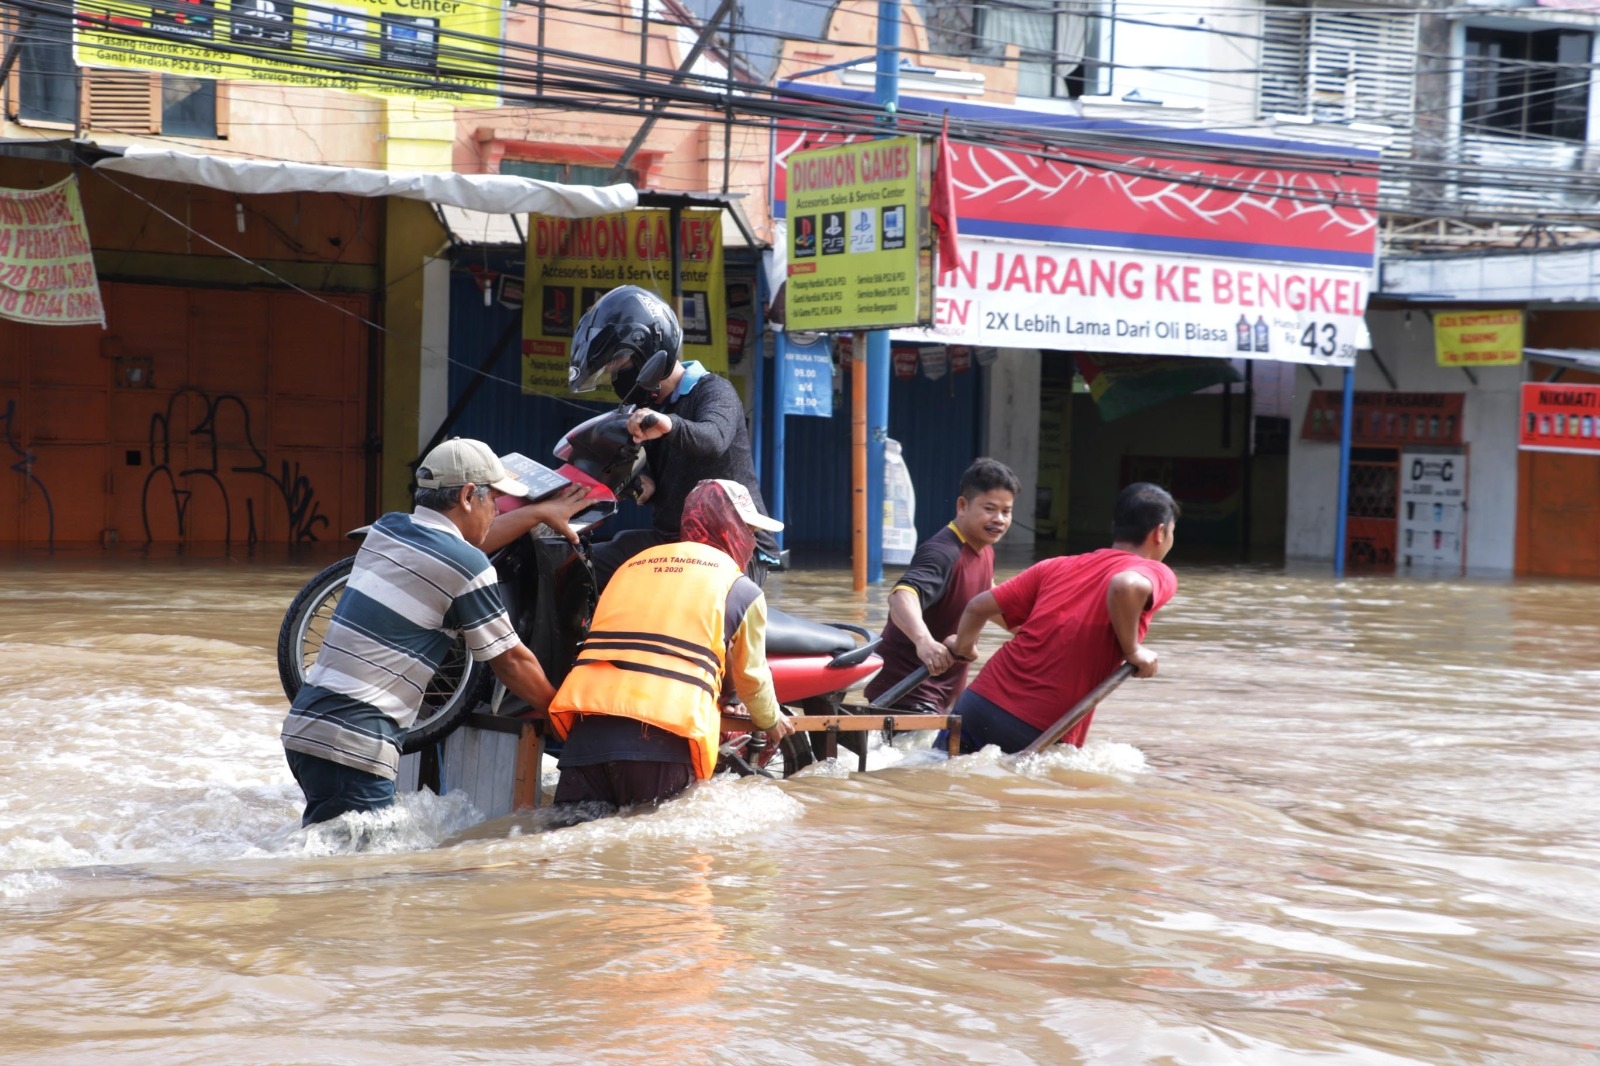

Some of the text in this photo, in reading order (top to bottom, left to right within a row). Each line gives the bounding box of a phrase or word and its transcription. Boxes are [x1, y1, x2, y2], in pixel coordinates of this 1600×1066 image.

[96, 50, 127, 62] Ganti
[128, 53, 169, 67] Hardisk
[793, 144, 910, 192] DIGIMON GAMES
[796, 195, 830, 209] Accesories
[831, 194, 848, 206] Sales
[855, 190, 880, 203] Service
[881, 187, 906, 199] Center
[536, 216, 629, 261] DIGIMON
[541, 264, 709, 283] Accesories Sales & Service enter
[987, 252, 1144, 300] JARANG
[1155, 263, 1202, 303] KE
[1212, 268, 1365, 317] BENGKEL
[986, 311, 1009, 331] 2X
[1014, 313, 1061, 334] Lebih
[1066, 316, 1111, 336] Lama
[1116, 319, 1150, 338] Dari
[1154, 321, 1180, 340] Oli
[1185, 323, 1228, 342] Biasa
[1538, 389, 1596, 408] NIKMATI
[670, 556, 720, 568] TANGERANG
